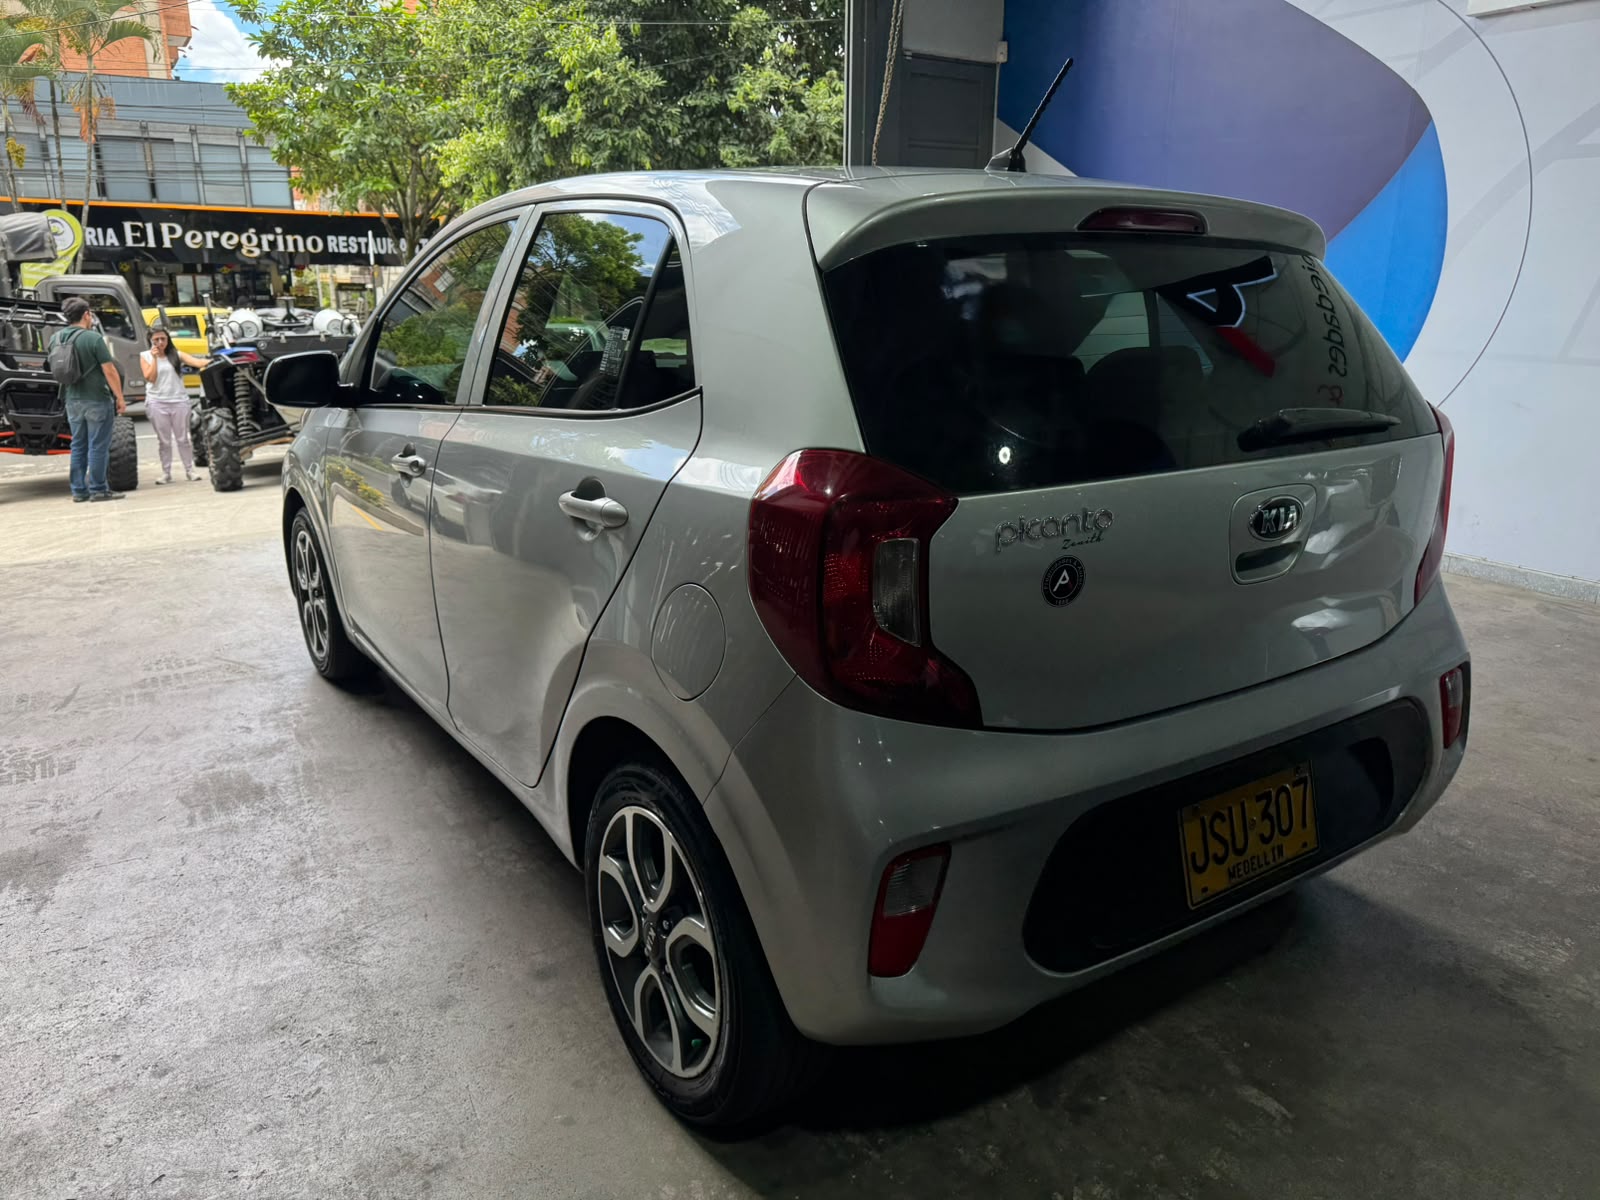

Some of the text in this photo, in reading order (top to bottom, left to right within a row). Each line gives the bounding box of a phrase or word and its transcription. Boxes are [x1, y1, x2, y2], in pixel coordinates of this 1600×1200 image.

[122, 221, 156, 248] El
[159, 222, 324, 258] Peregrino
[995, 508, 1113, 553] picanto
[1260, 505, 1297, 534] KIA
[1062, 530, 1104, 549] Zenith
[1191, 775, 1310, 874] JSU 307
[1227, 845, 1284, 880] MEDELLIN
